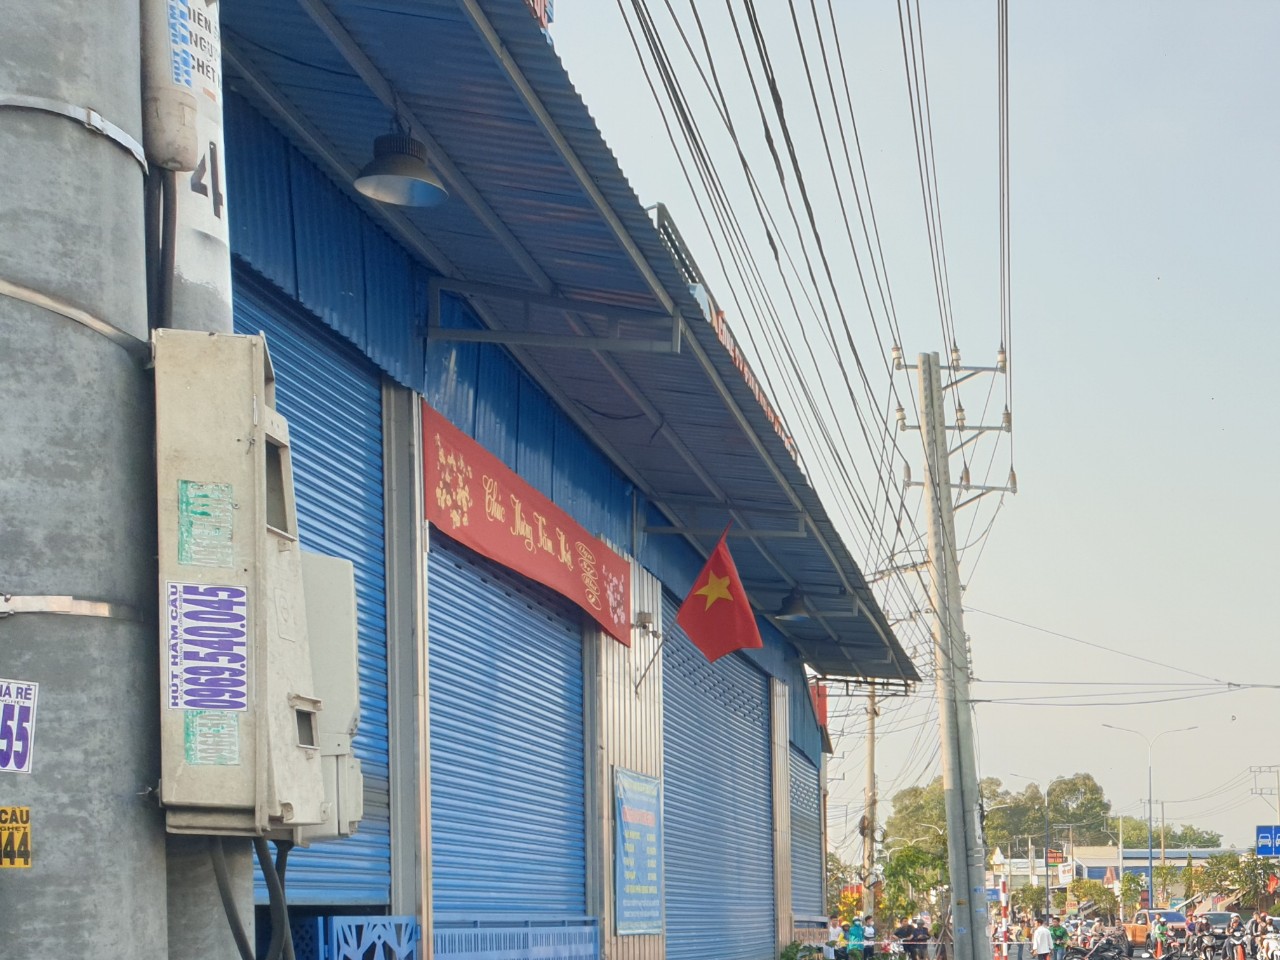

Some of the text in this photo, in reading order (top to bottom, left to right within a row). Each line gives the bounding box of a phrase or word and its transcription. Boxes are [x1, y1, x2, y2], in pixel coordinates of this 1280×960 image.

[190, 140, 224, 220] 4
[183, 585, 246, 709] 0969.540.045
[16, 684, 33, 700] RẺ
